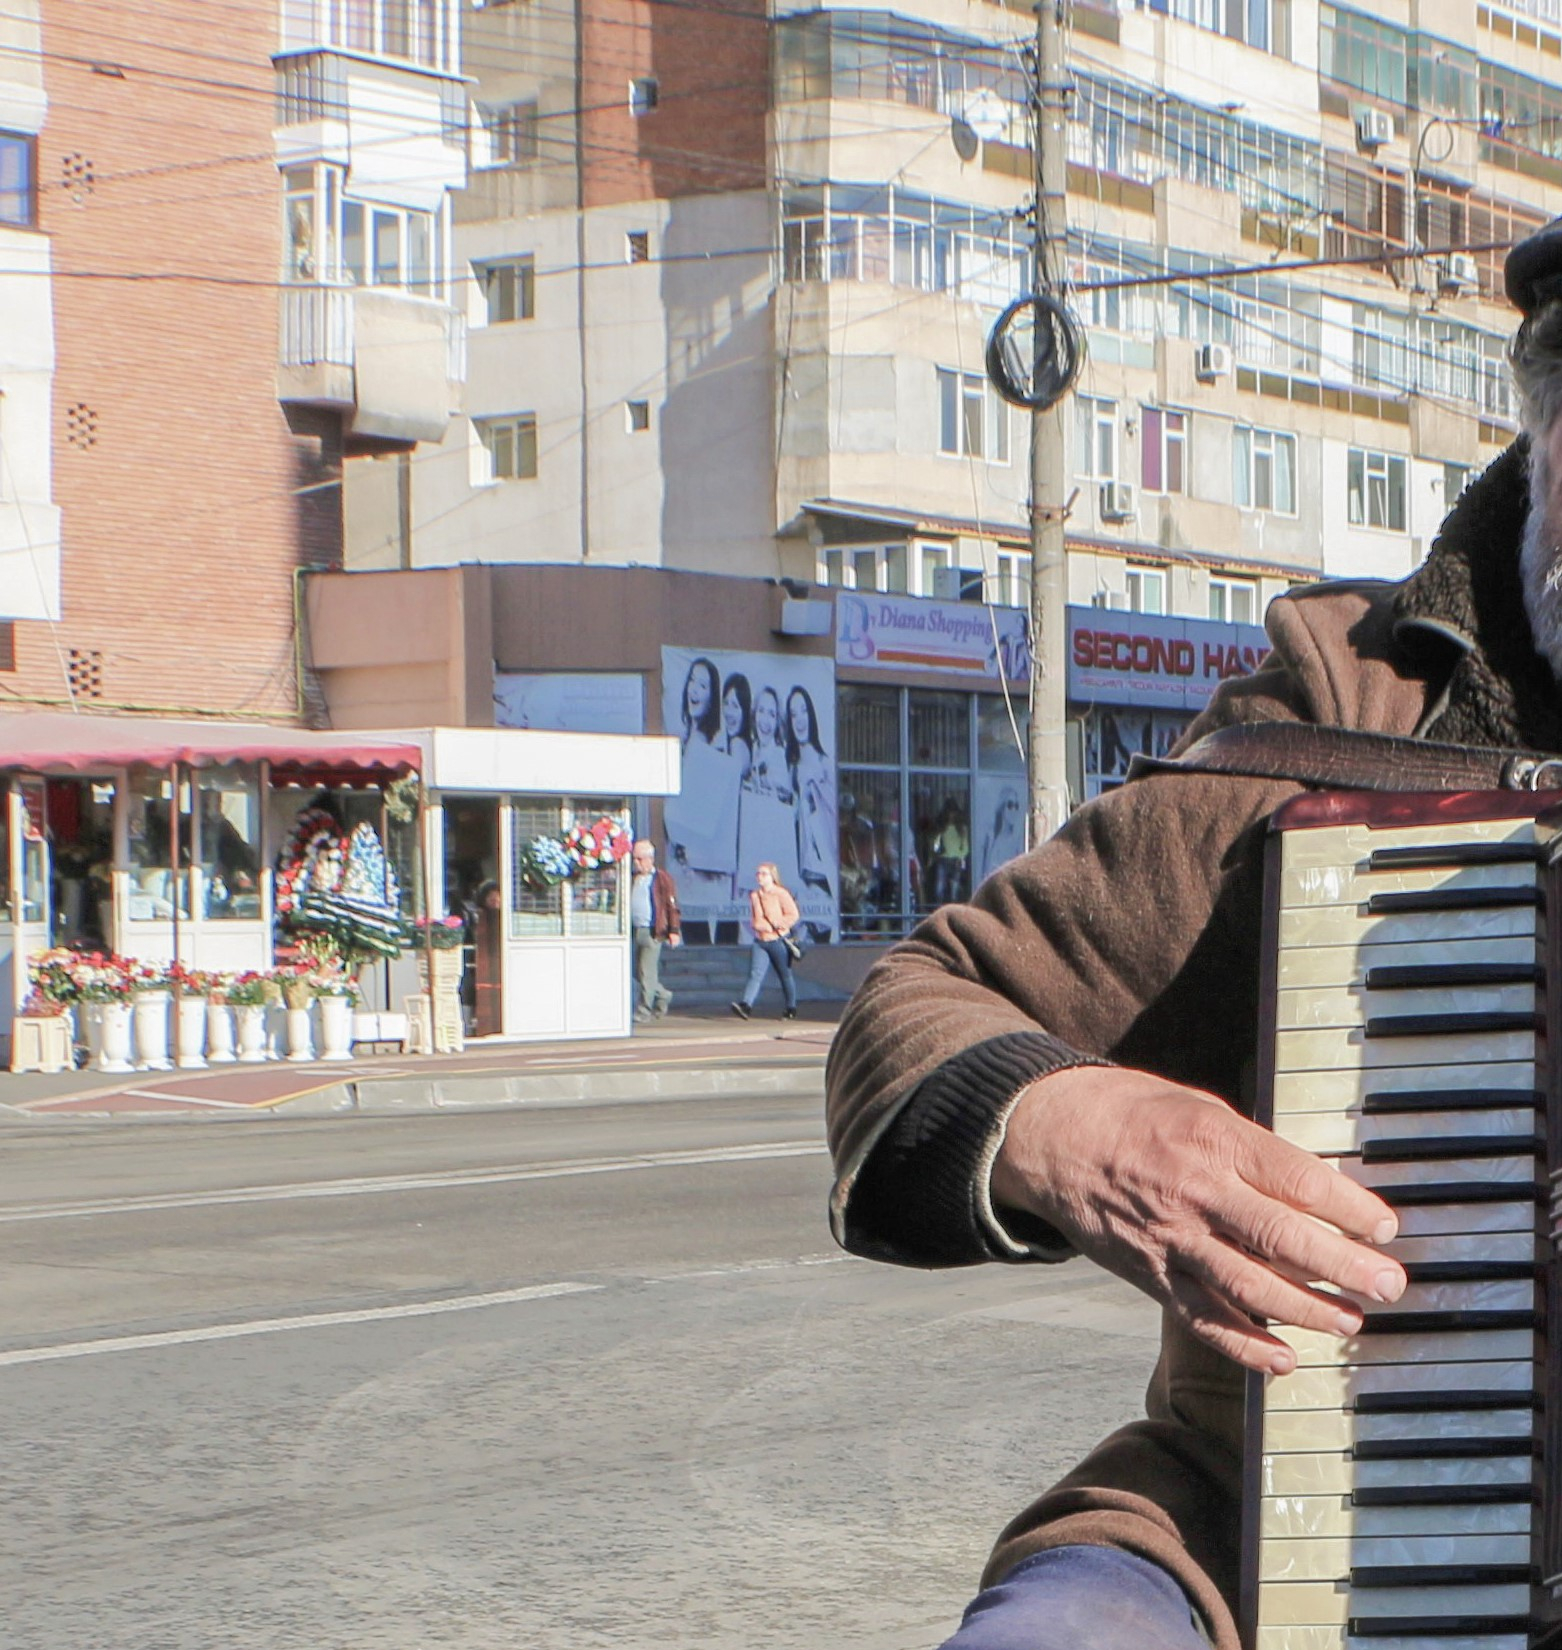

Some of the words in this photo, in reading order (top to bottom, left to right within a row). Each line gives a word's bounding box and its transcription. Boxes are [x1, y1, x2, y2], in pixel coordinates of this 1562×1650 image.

[879, 605, 925, 631] Diana
[928, 608, 993, 643] Shopping
[1073, 628, 1196, 677] SECOND
[1203, 642, 1271, 681] HAN
